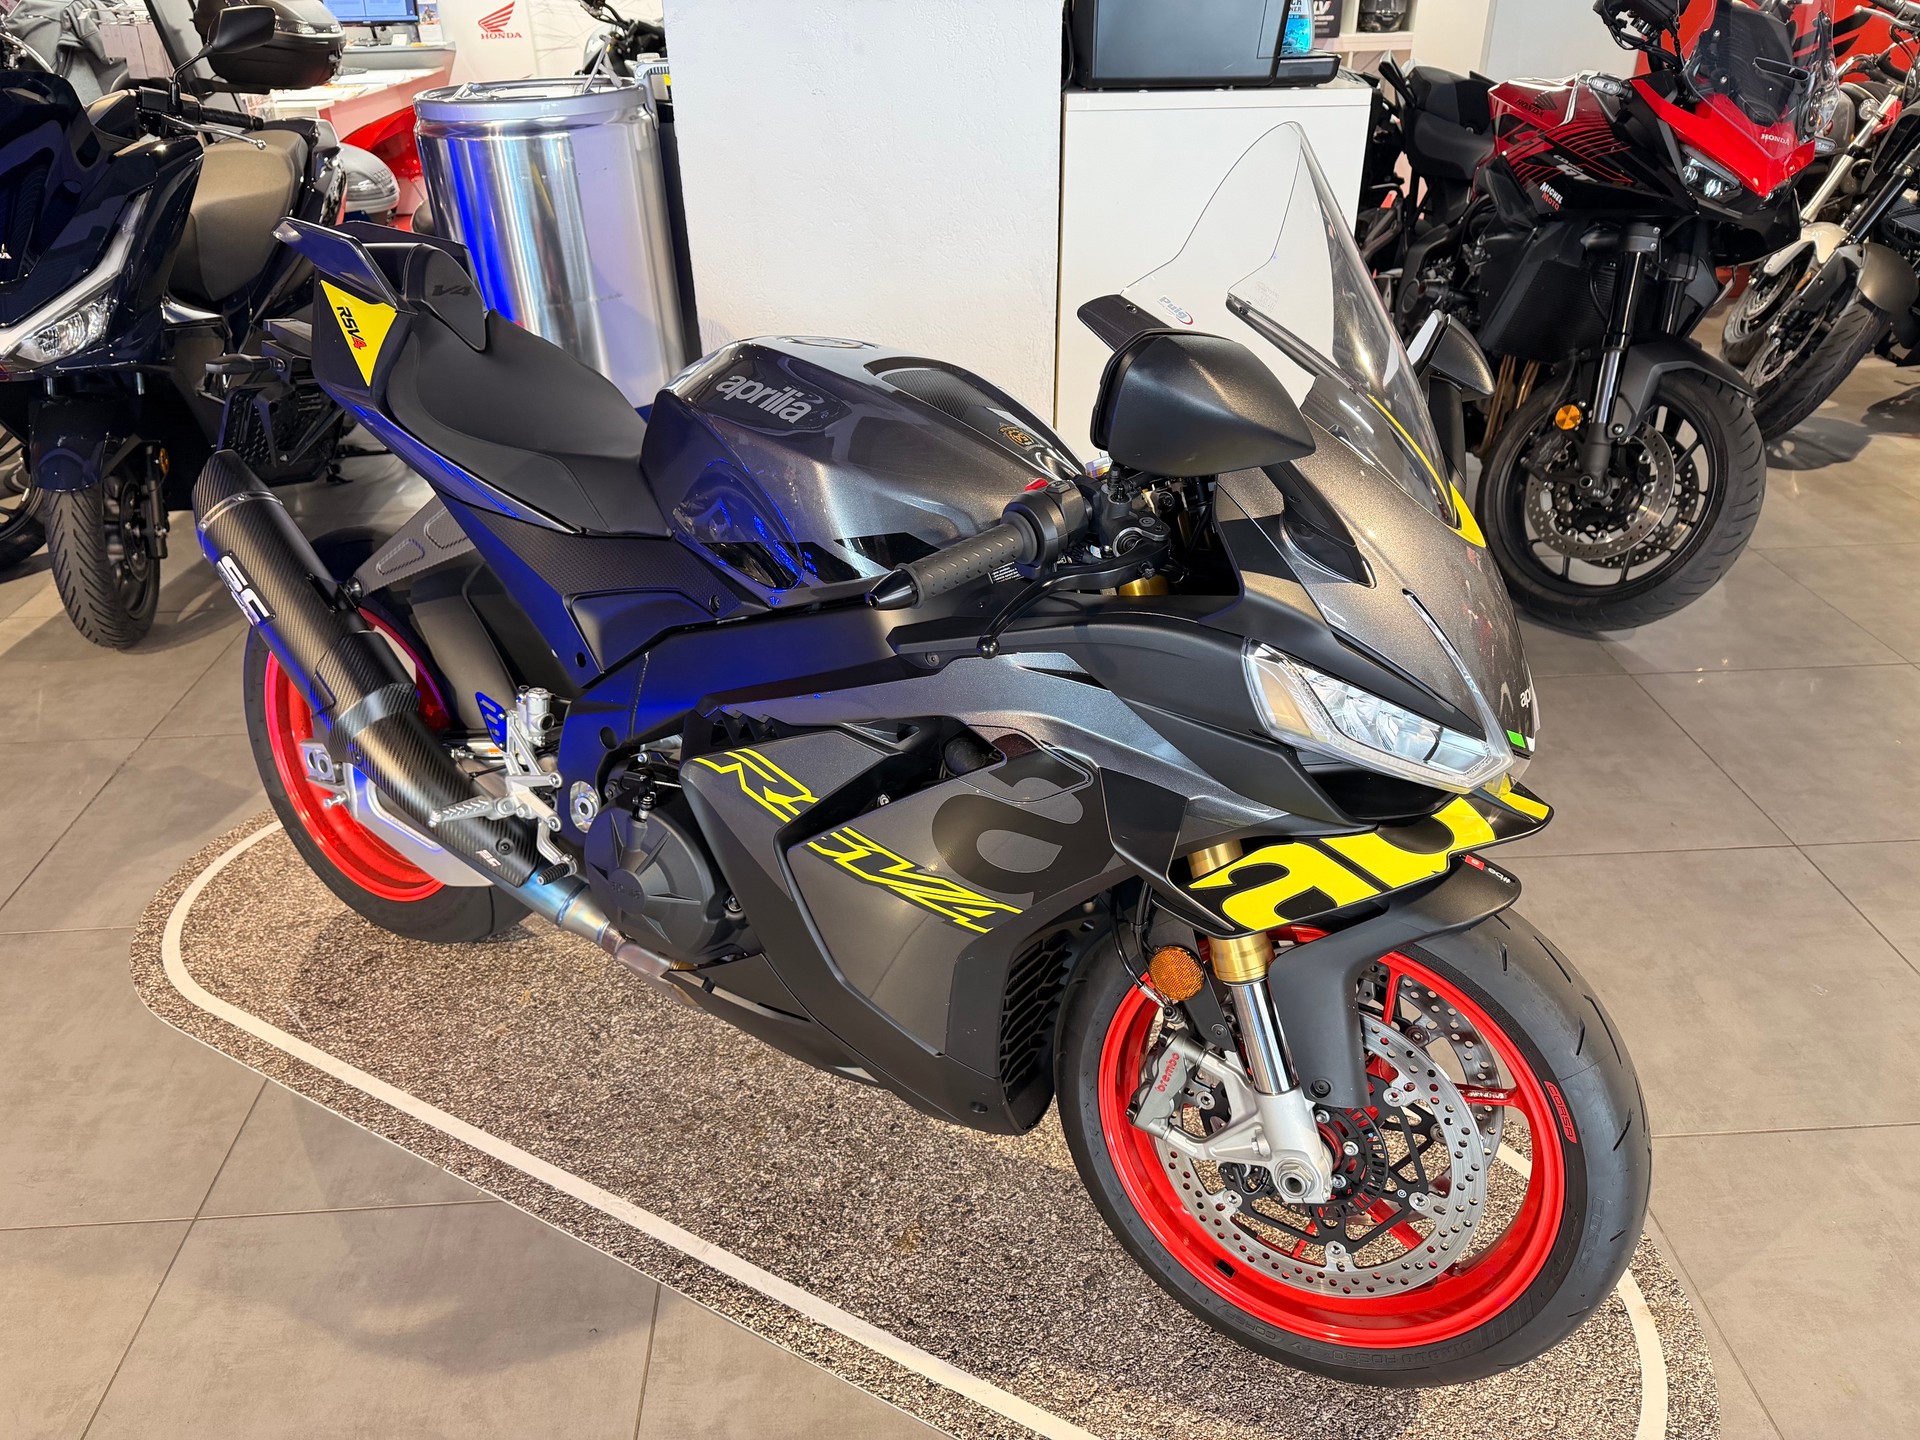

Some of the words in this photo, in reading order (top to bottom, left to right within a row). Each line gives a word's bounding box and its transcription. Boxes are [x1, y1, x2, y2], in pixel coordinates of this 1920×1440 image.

[1514, 99, 1545, 118] HONDA
[1761, 133, 1790, 146] HONDA
[1540, 181, 1564, 204] MICHEL
[1541, 192, 1560, 211] MOTO
[1159, 296, 1188, 321] Puig
[336, 306, 368, 350] RSV4
[716, 375, 812, 424] aprilia
[1155, 1052, 1180, 1093] brembo
[1547, 1085, 1574, 1137] CORSA
